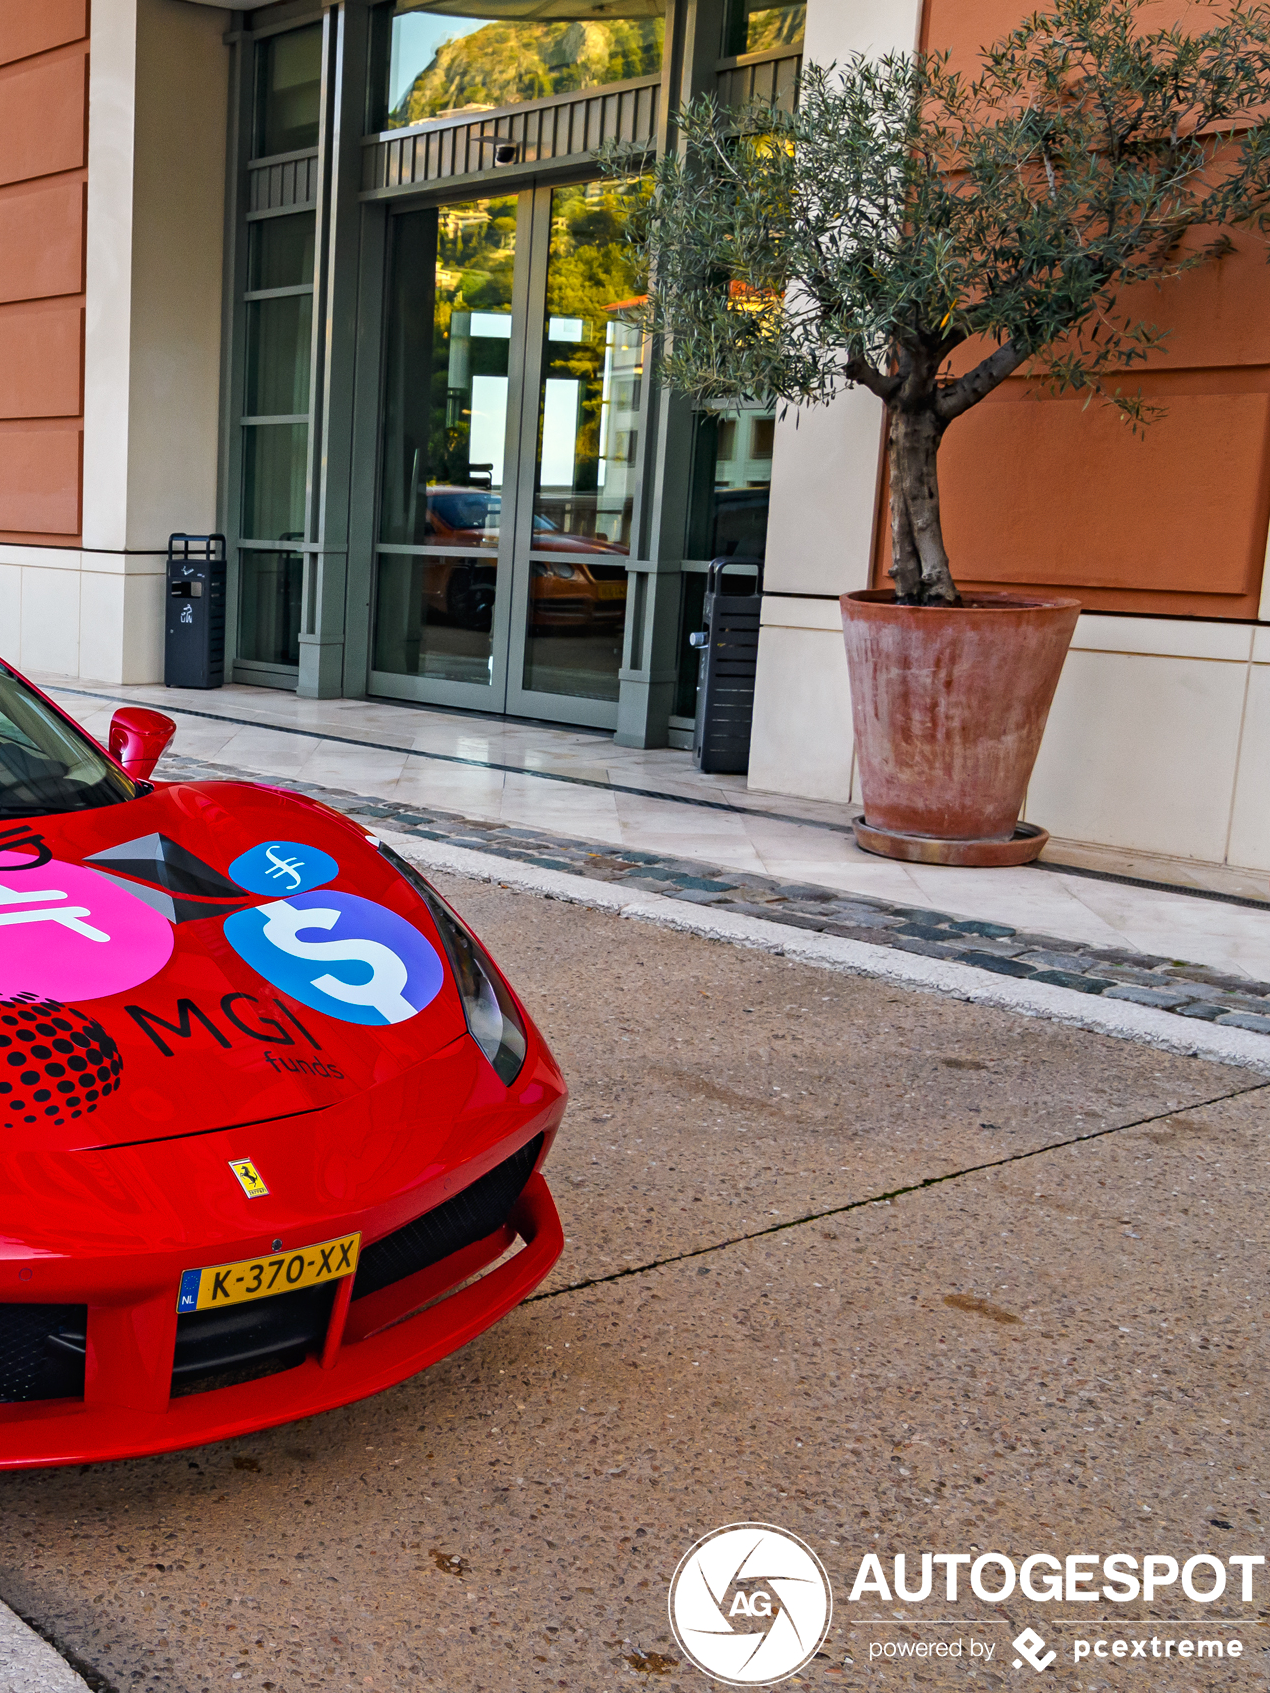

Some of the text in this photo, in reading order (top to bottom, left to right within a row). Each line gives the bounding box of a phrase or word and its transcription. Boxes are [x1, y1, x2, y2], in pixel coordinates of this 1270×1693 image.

[124, 992, 322, 1057] MGI
[263, 1050, 345, 1080] funds
[211, 1239, 355, 1301] K-370-XX
[181, 1295, 195, 1305] NL
